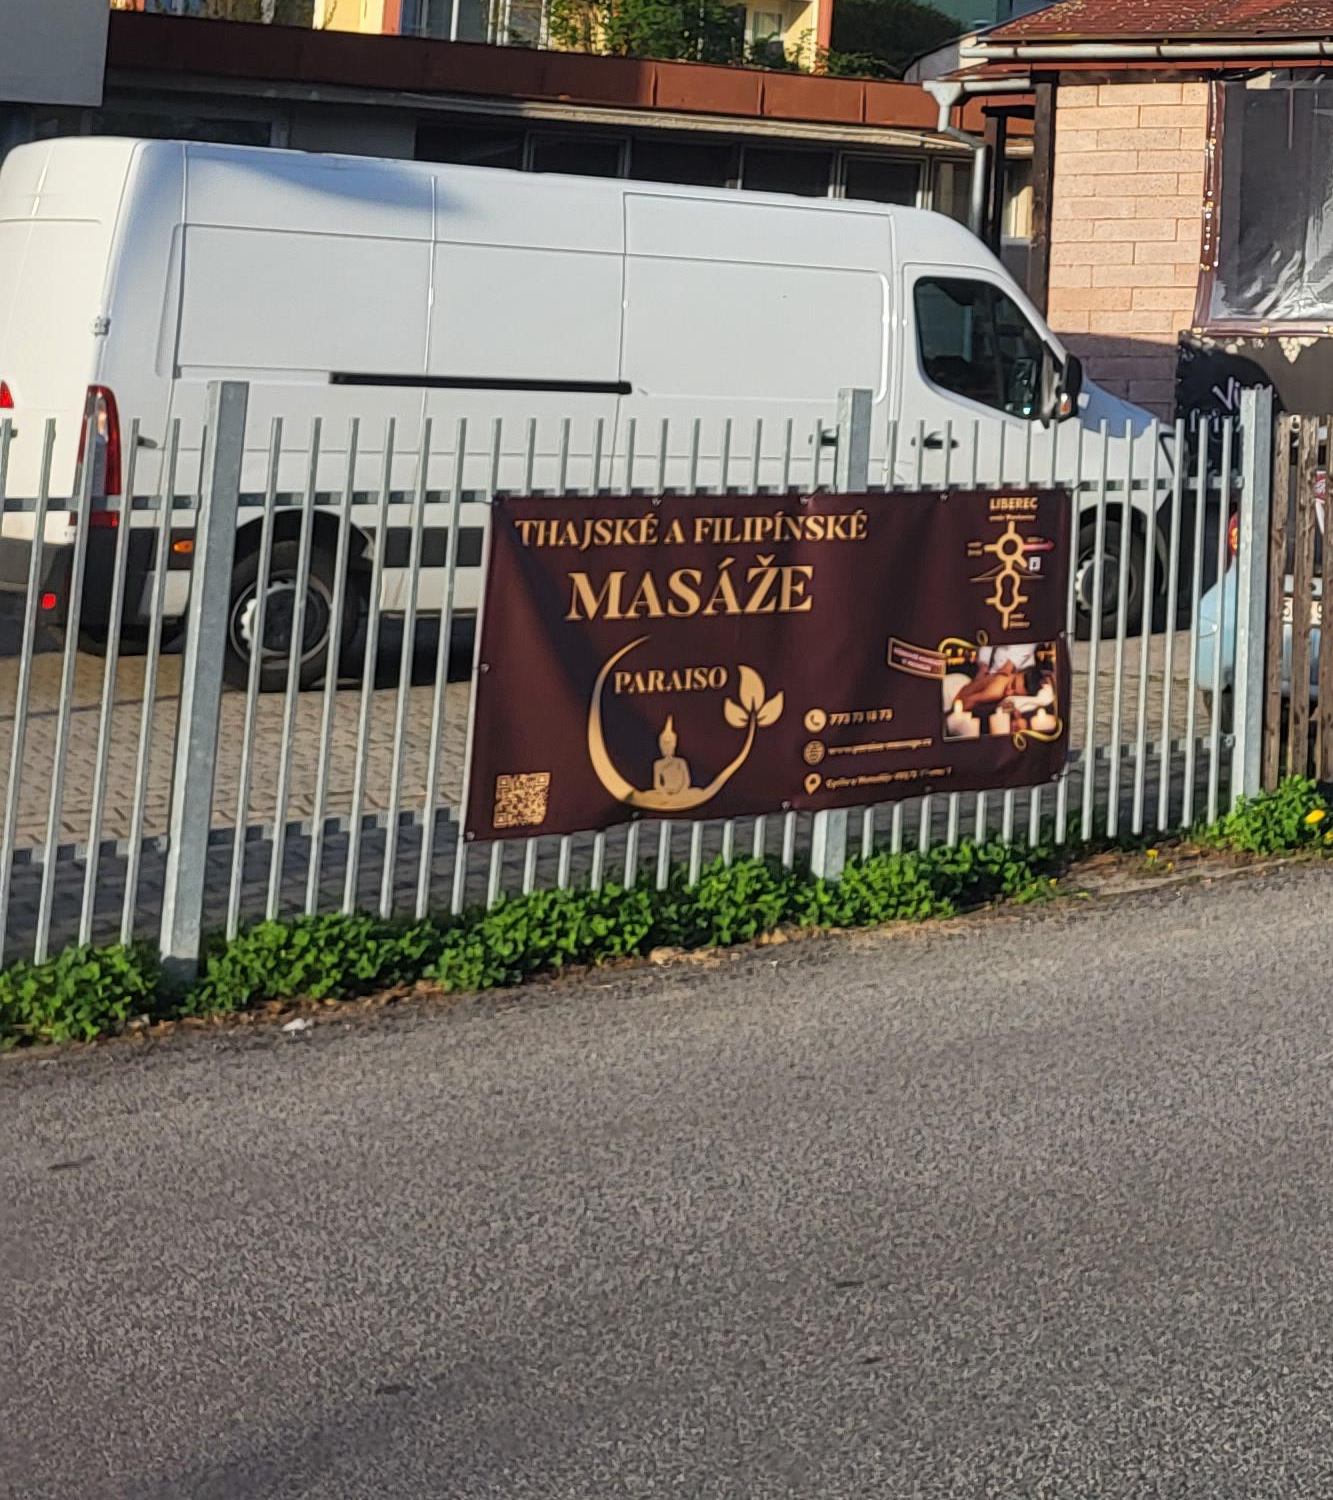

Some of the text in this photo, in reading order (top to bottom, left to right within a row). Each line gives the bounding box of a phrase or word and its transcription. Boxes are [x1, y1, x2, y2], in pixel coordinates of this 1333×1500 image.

[989, 497, 1038, 511] LIBEREC
[515, 510, 869, 551] THAJSKÉ A FILIPÍNSKÉ
[564, 553, 814, 622] MASÁŽE
[614, 666, 729, 695] PARAISO
